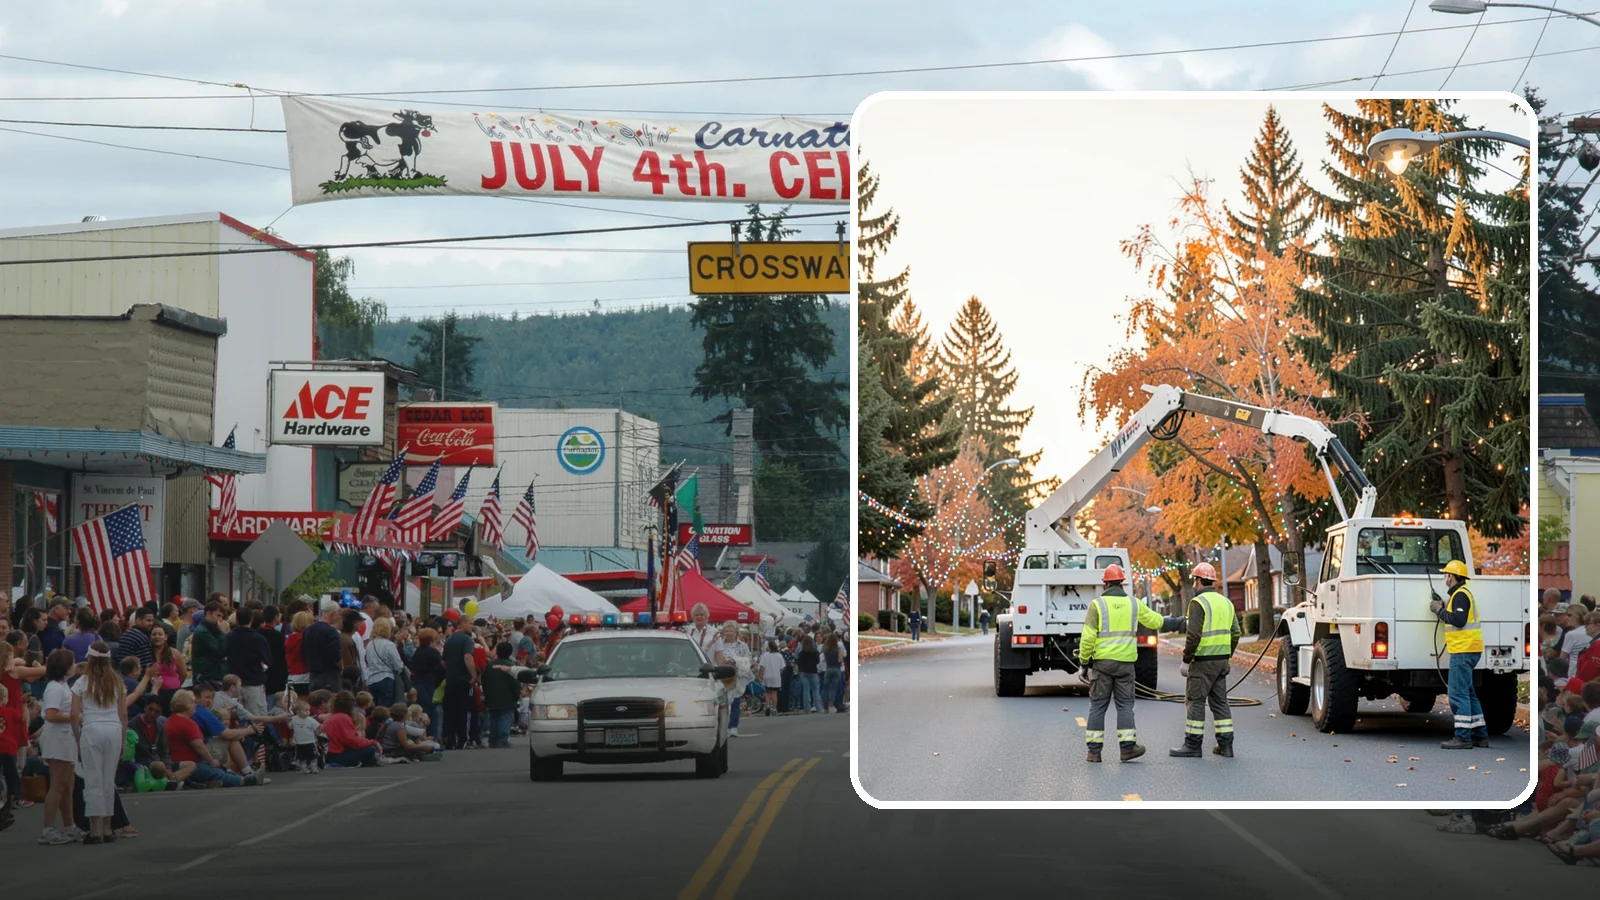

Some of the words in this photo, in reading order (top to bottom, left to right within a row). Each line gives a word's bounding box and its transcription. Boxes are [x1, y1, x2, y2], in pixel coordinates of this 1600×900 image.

[695, 121, 850, 150] Carnat
[481, 141, 604, 192] JULY
[632, 150, 746, 198] 4th.
[696, 254, 850, 280] CROSSWA
[282, 380, 374, 420] ACE
[407, 409, 452, 422] CEDAR
[283, 421, 371, 437] Hardware
[416, 428, 478, 447] Coca-Cola
[95, 485, 124, 495] Vincent
[126, 485, 136, 495] de
[138, 486, 155, 495] Paul
[688, 526, 741, 535] CRNATION
[699, 535, 731, 543] GLASS
